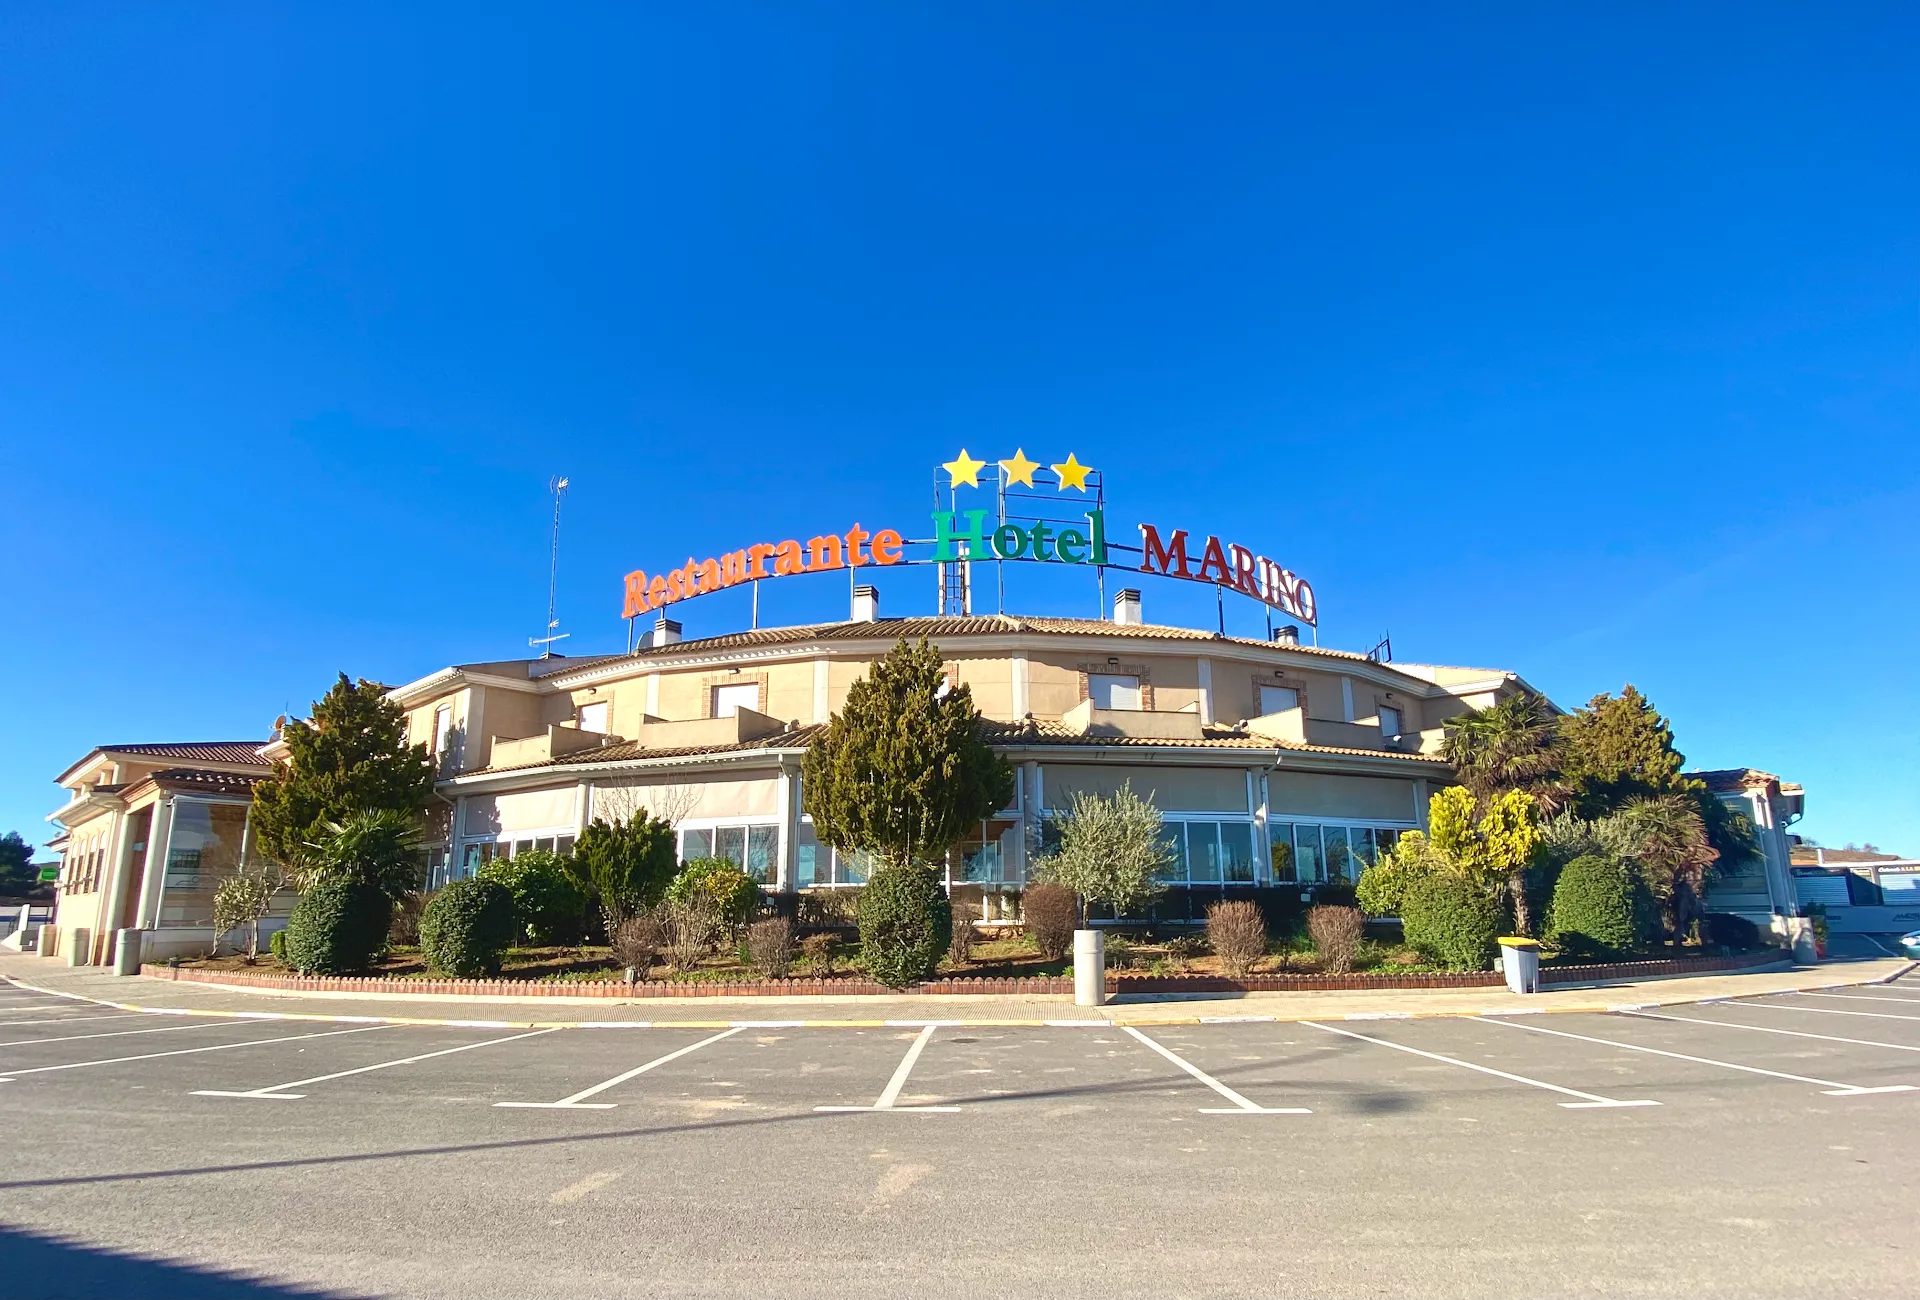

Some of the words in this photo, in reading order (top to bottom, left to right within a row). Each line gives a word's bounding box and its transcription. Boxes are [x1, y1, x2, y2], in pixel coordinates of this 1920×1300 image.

[621, 522, 904, 619] Restaurante
[930, 509, 1108, 565] Hotel
[1137, 523, 1317, 624] MARINO
